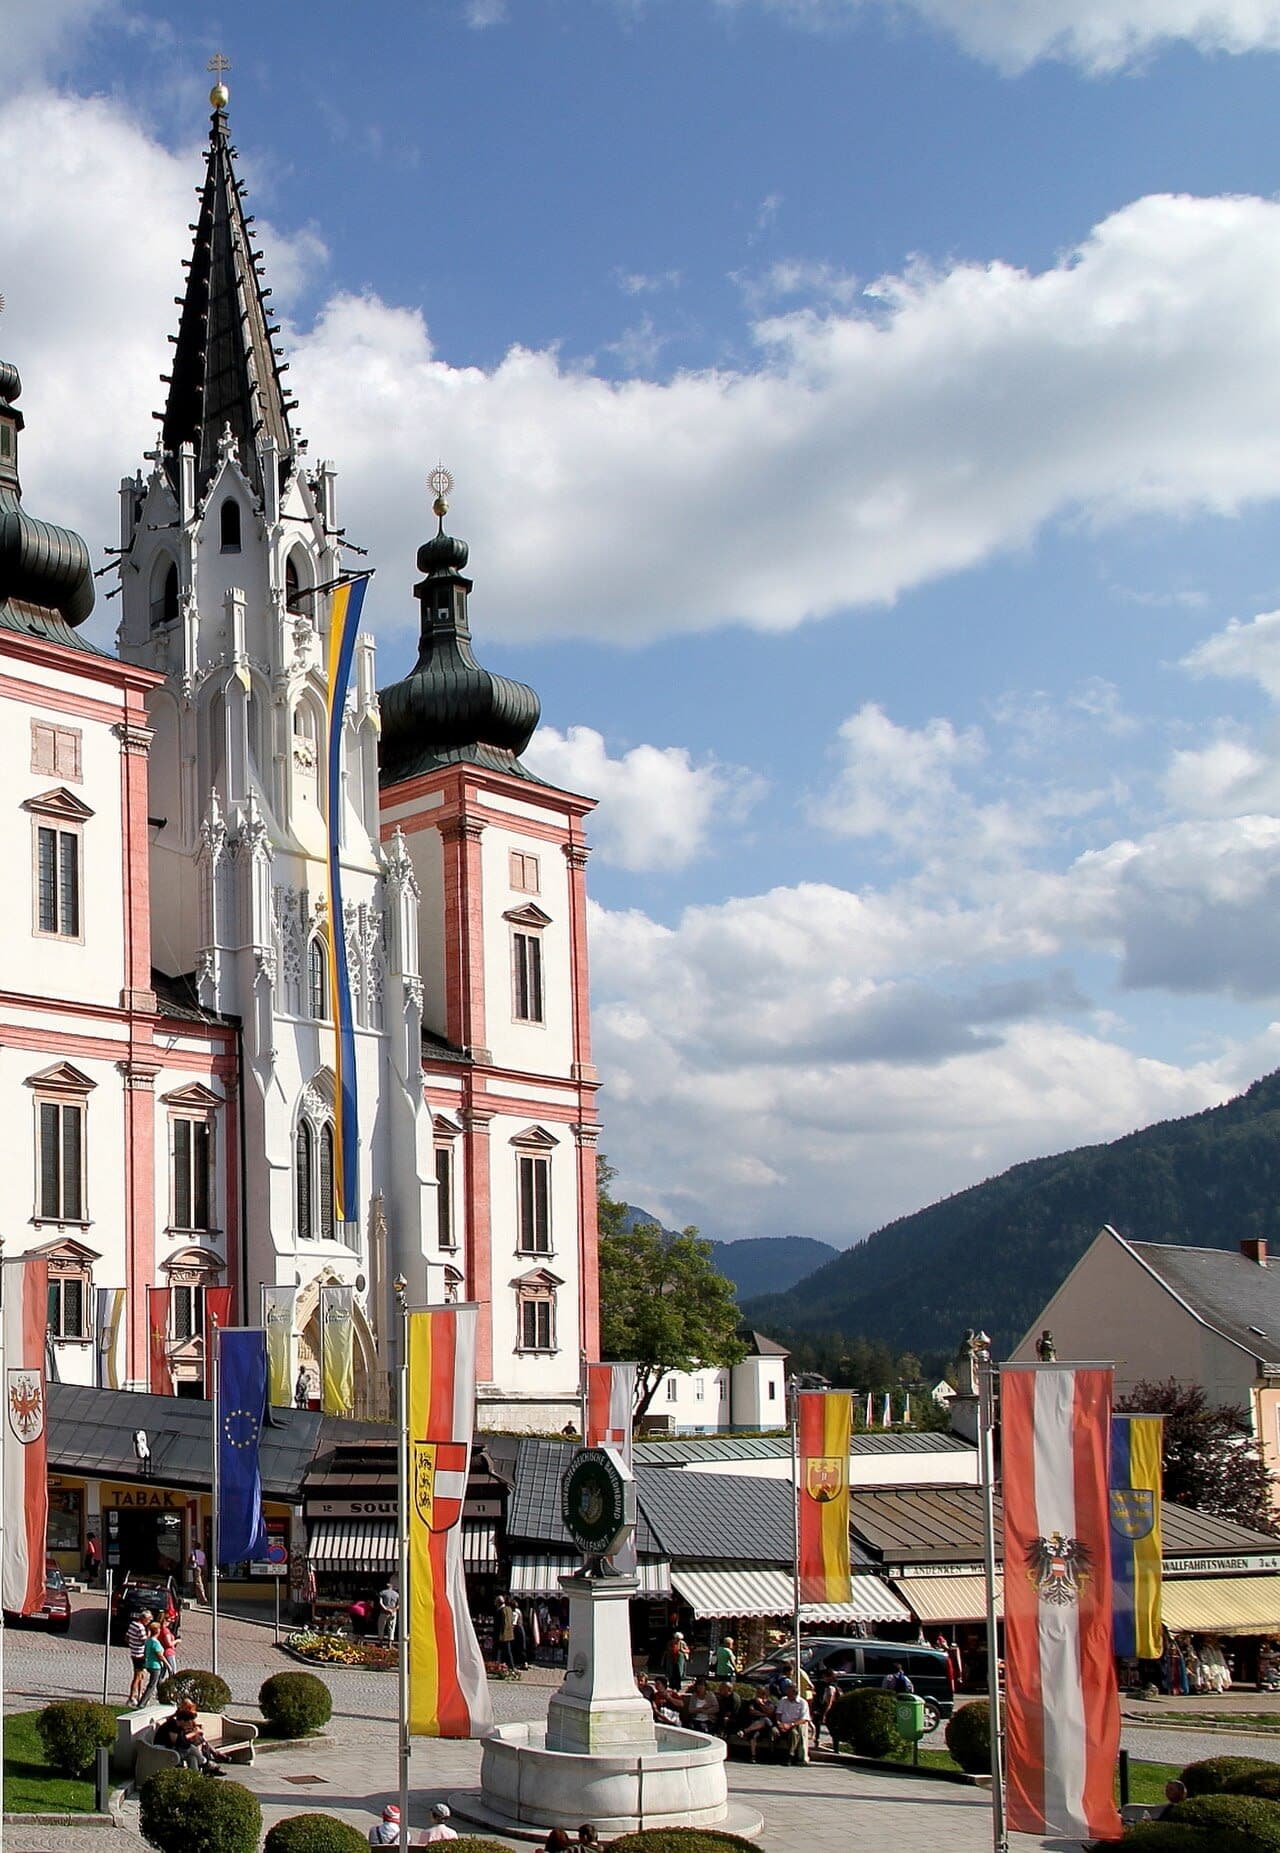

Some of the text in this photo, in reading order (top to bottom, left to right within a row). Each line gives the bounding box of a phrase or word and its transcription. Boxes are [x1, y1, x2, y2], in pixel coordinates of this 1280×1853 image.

[112, 1491, 174, 1506] TABAK
[912, 1565, 962, 1575] ANDENKEN
[1162, 1559, 1249, 1572] WALLFAHRTSWAREN
